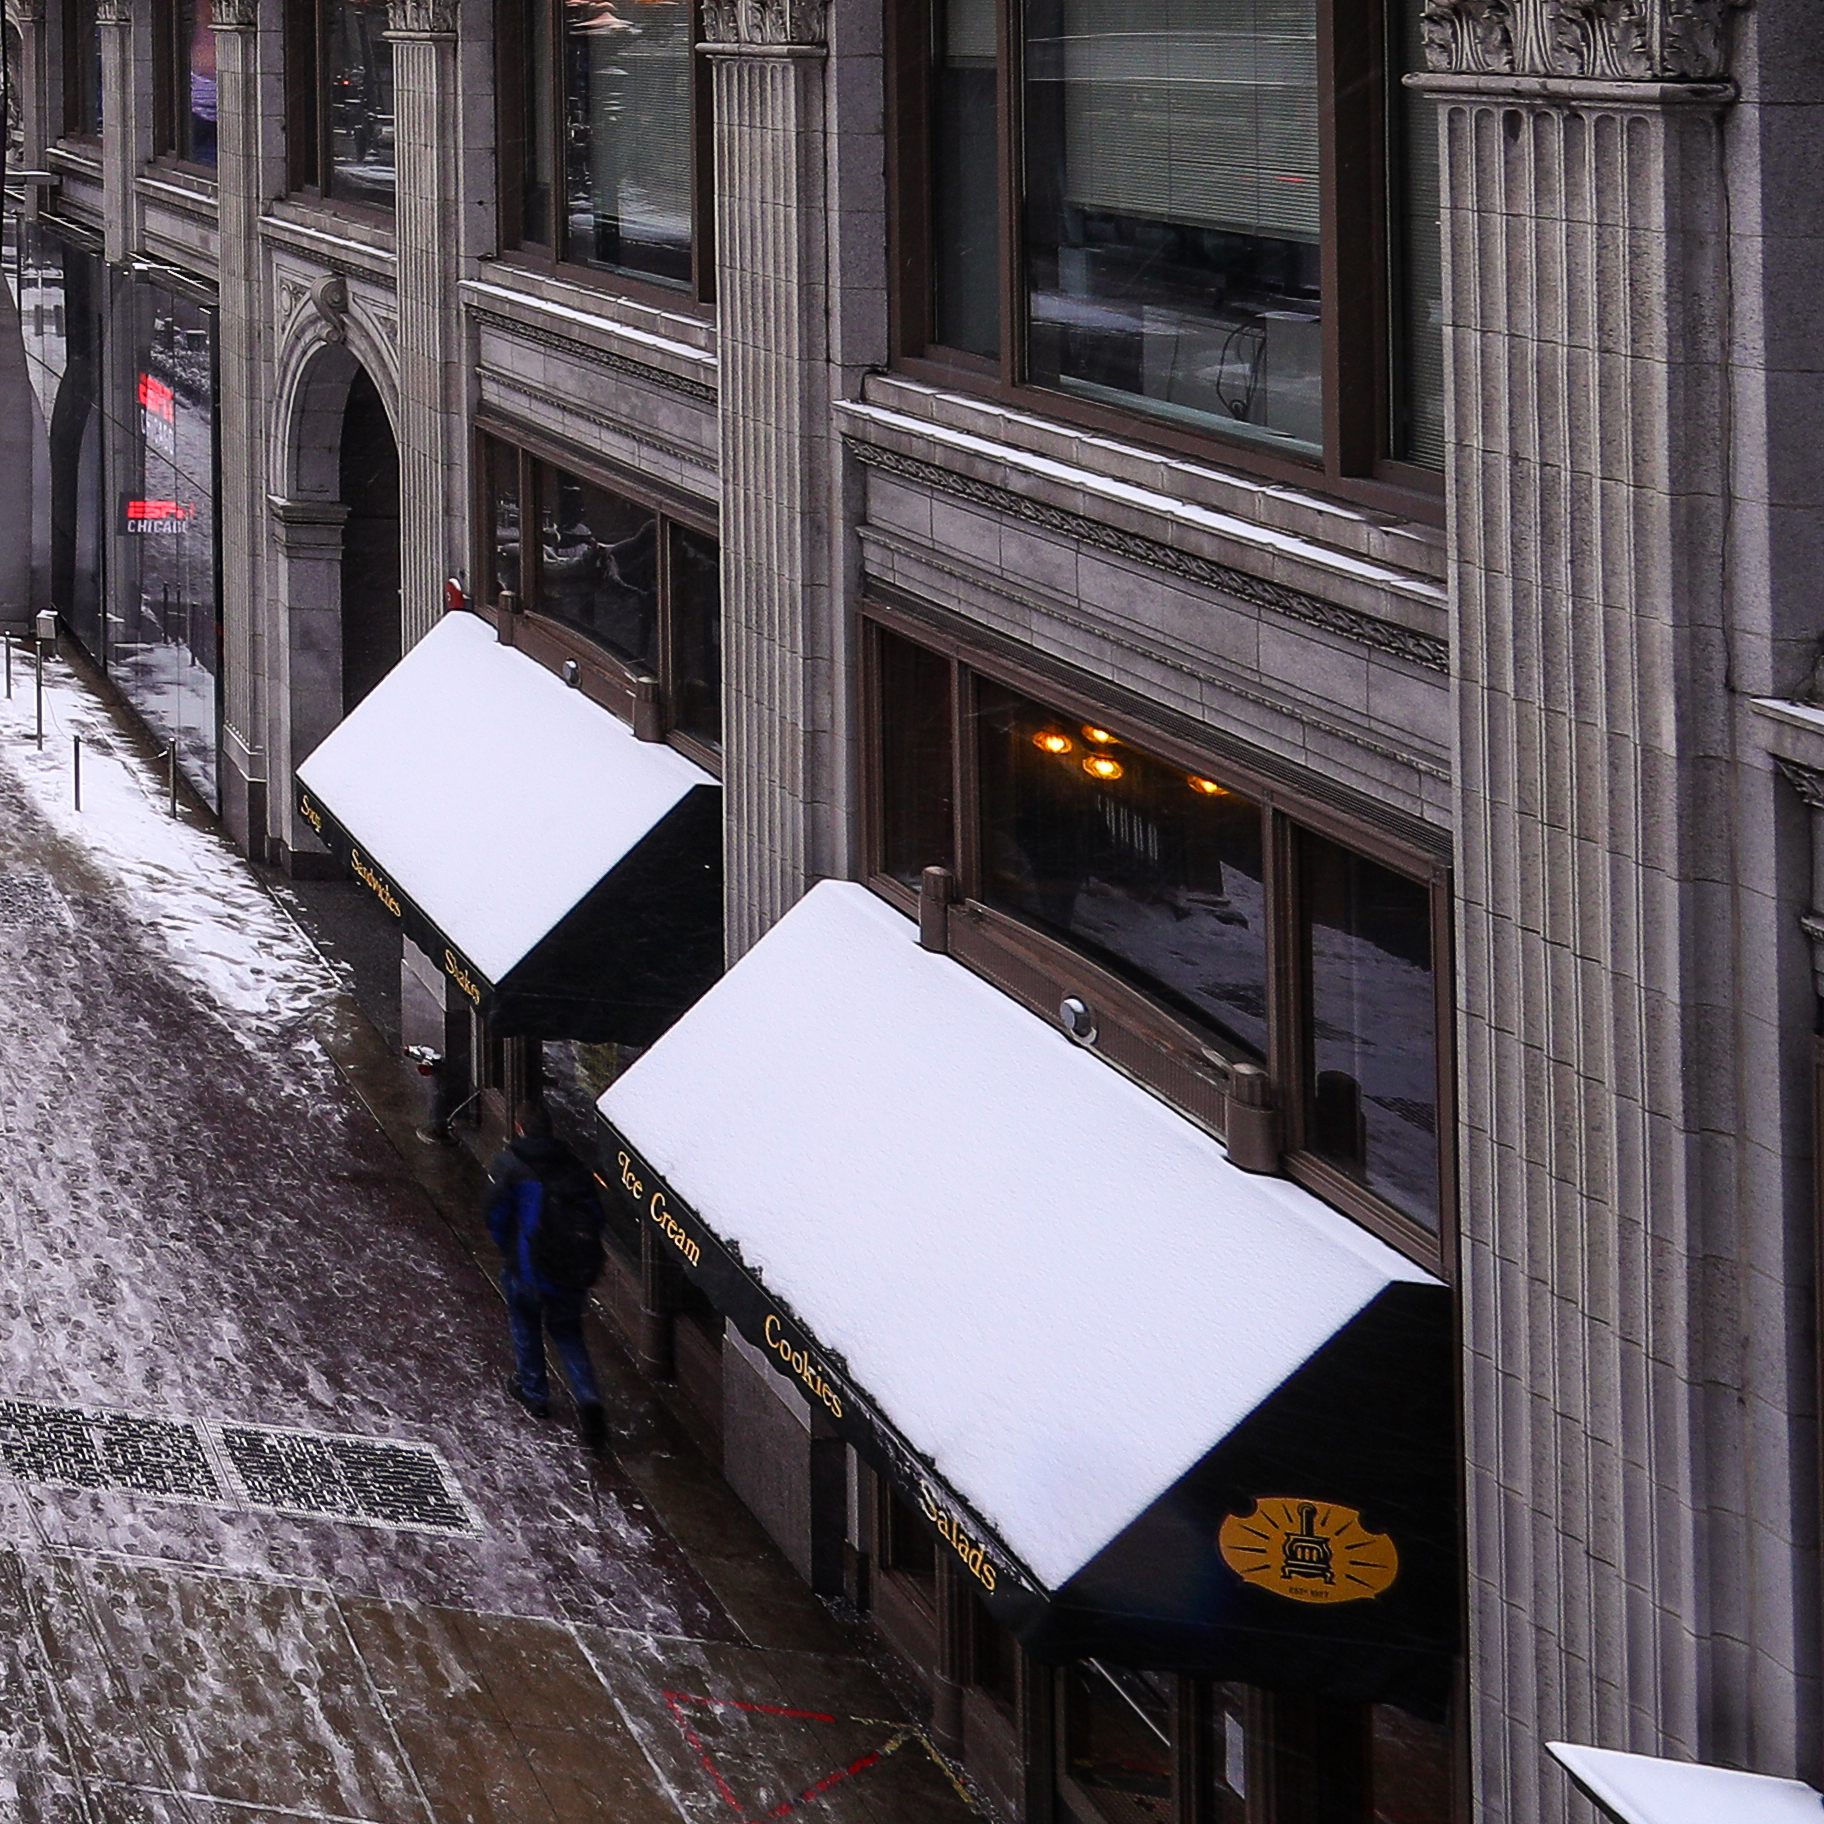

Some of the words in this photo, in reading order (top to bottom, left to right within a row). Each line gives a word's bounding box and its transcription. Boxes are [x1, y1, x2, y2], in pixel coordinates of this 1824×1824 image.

[617, 1150, 644, 1199] Ice
[650, 1192, 702, 1267] Cream
[764, 1314, 843, 1419] Cookies
[916, 1478, 997, 1592] Salads
